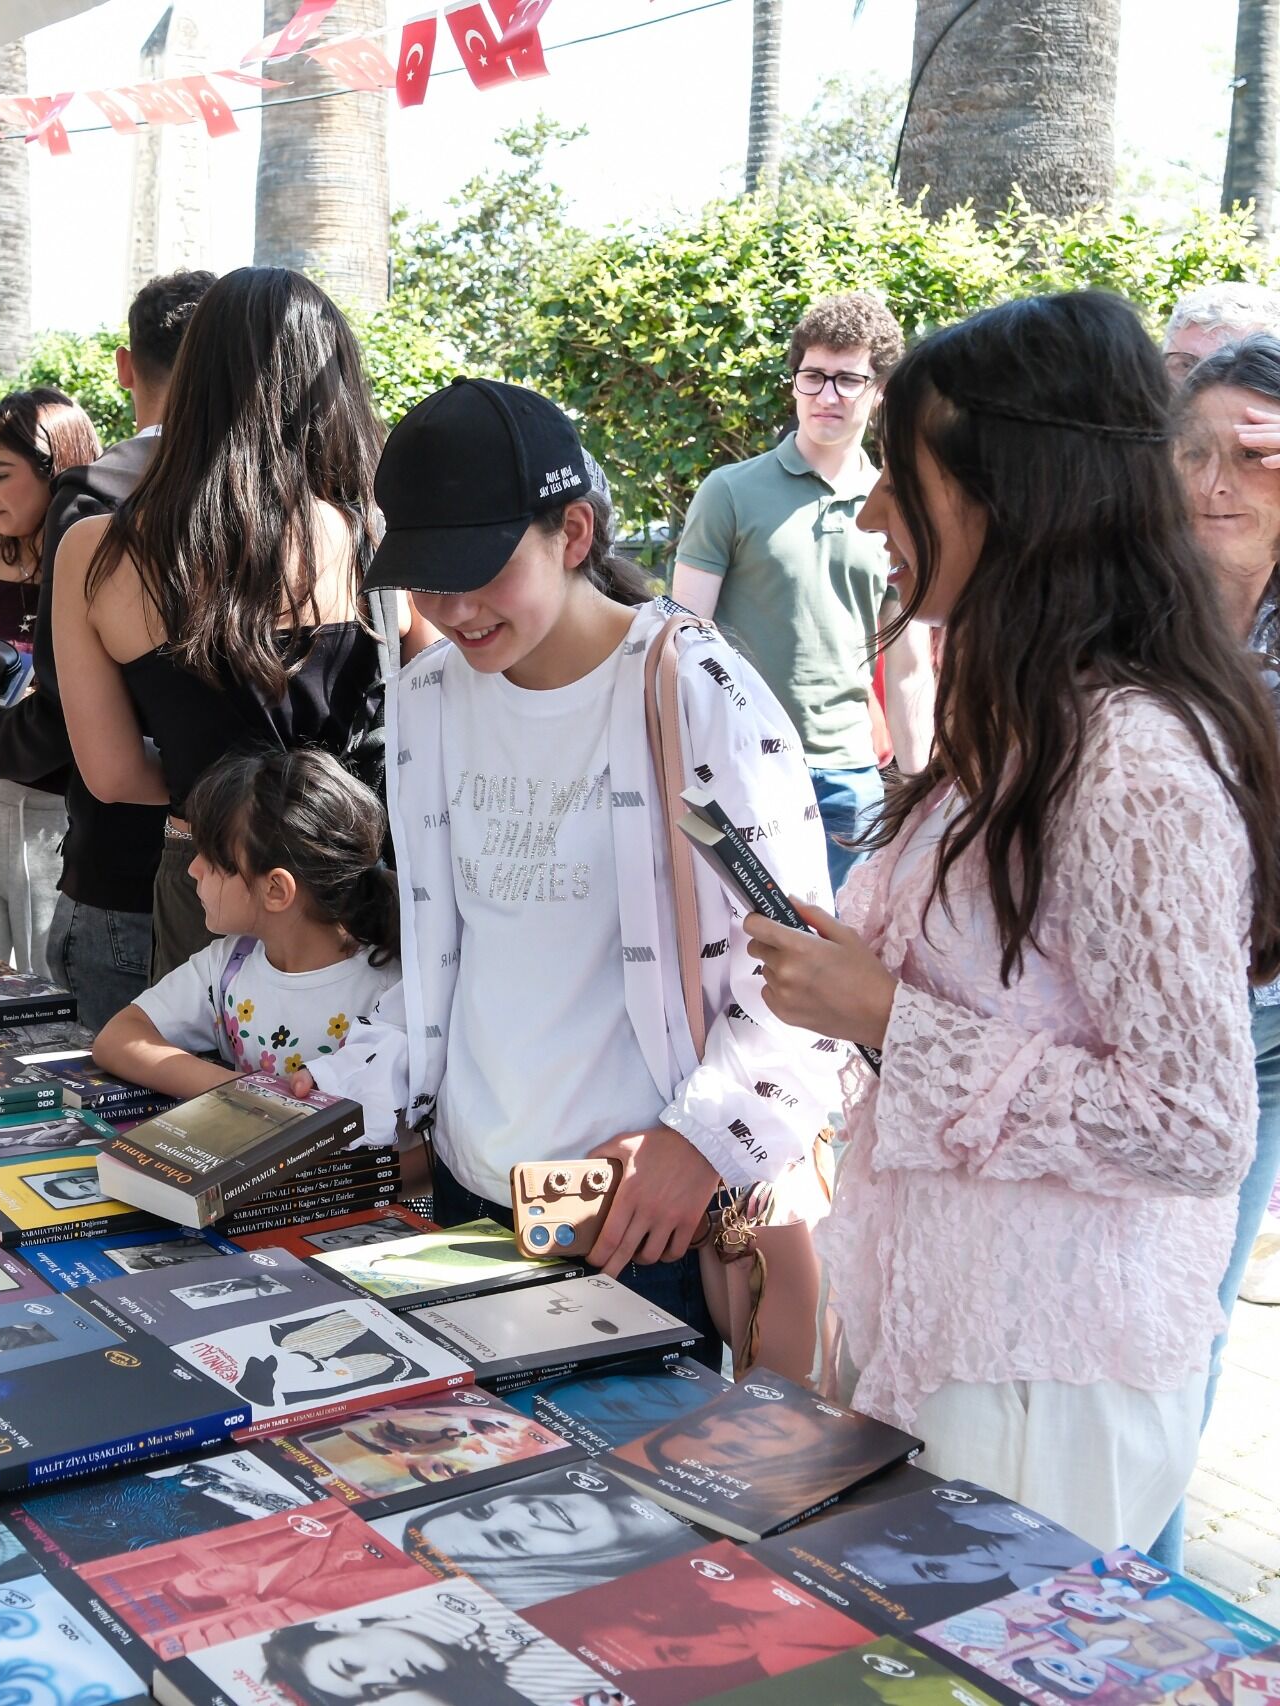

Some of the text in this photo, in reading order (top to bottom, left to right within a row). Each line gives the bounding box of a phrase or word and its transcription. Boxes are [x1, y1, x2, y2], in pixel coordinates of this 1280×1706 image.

[550, 482, 562, 494] LESS
[698, 657, 731, 686] NIKE
[722, 684, 747, 712] AIR
[473, 774, 542, 816] ONLY
[756, 820, 782, 842] AIR
[722, 822, 762, 875] SABAHATTİN
[758, 870, 770, 884] ALİ
[770, 888, 786, 911] Canım
[731, 860, 776, 921] SABAHATTİN
[700, 940, 727, 960] NIKE
[108, 1088, 156, 1102] ORHAN PAMU
[773, 1088, 800, 1109] AIR
[96, 1110, 118, 1120] RHAN
[118, 1106, 144, 1117] PAMUK
[111, 1140, 193, 1184] Orhan Pamuk
[154, 1142, 212, 1173] Masumiyet
[184, 1145, 225, 1168] Müzesi
[743, 1138, 768, 1164] AIR
[224, 1134, 336, 1200] ORHAN PAMUK Masumiyet Müzesi
[332, 1163, 352, 1172] Esirler
[278, 1178, 353, 1196] ALİ Kağnı Ses Esirler
[233, 1192, 356, 1220] SABAHATTİN ALİ Kağnı Ses Esirler
[22, 1218, 108, 1238] SABAHATTİN ALİ Değirmen
[227, 1206, 350, 1236] SABAHATTİN ALİ Kağnı Ses Esirler
[20, 1229, 108, 1248] SABAHATTİN ALİ Değirmen
[532, 1392, 580, 1427] Mektuplar
[248, 1422, 272, 1433] HALDUN
[272, 1418, 290, 1429] TANER
[34, 1460, 64, 1477] HALİT
[66, 1455, 87, 1470] ZİYA
[88, 1442, 136, 1464] UŞAKLIGİL
[148, 1436, 164, 1446] Mai
[174, 1428, 195, 1442] Siyah
[663, 1462, 741, 1500] Eski Bahçe
[680, 1458, 752, 1490] Eski Sevgi
